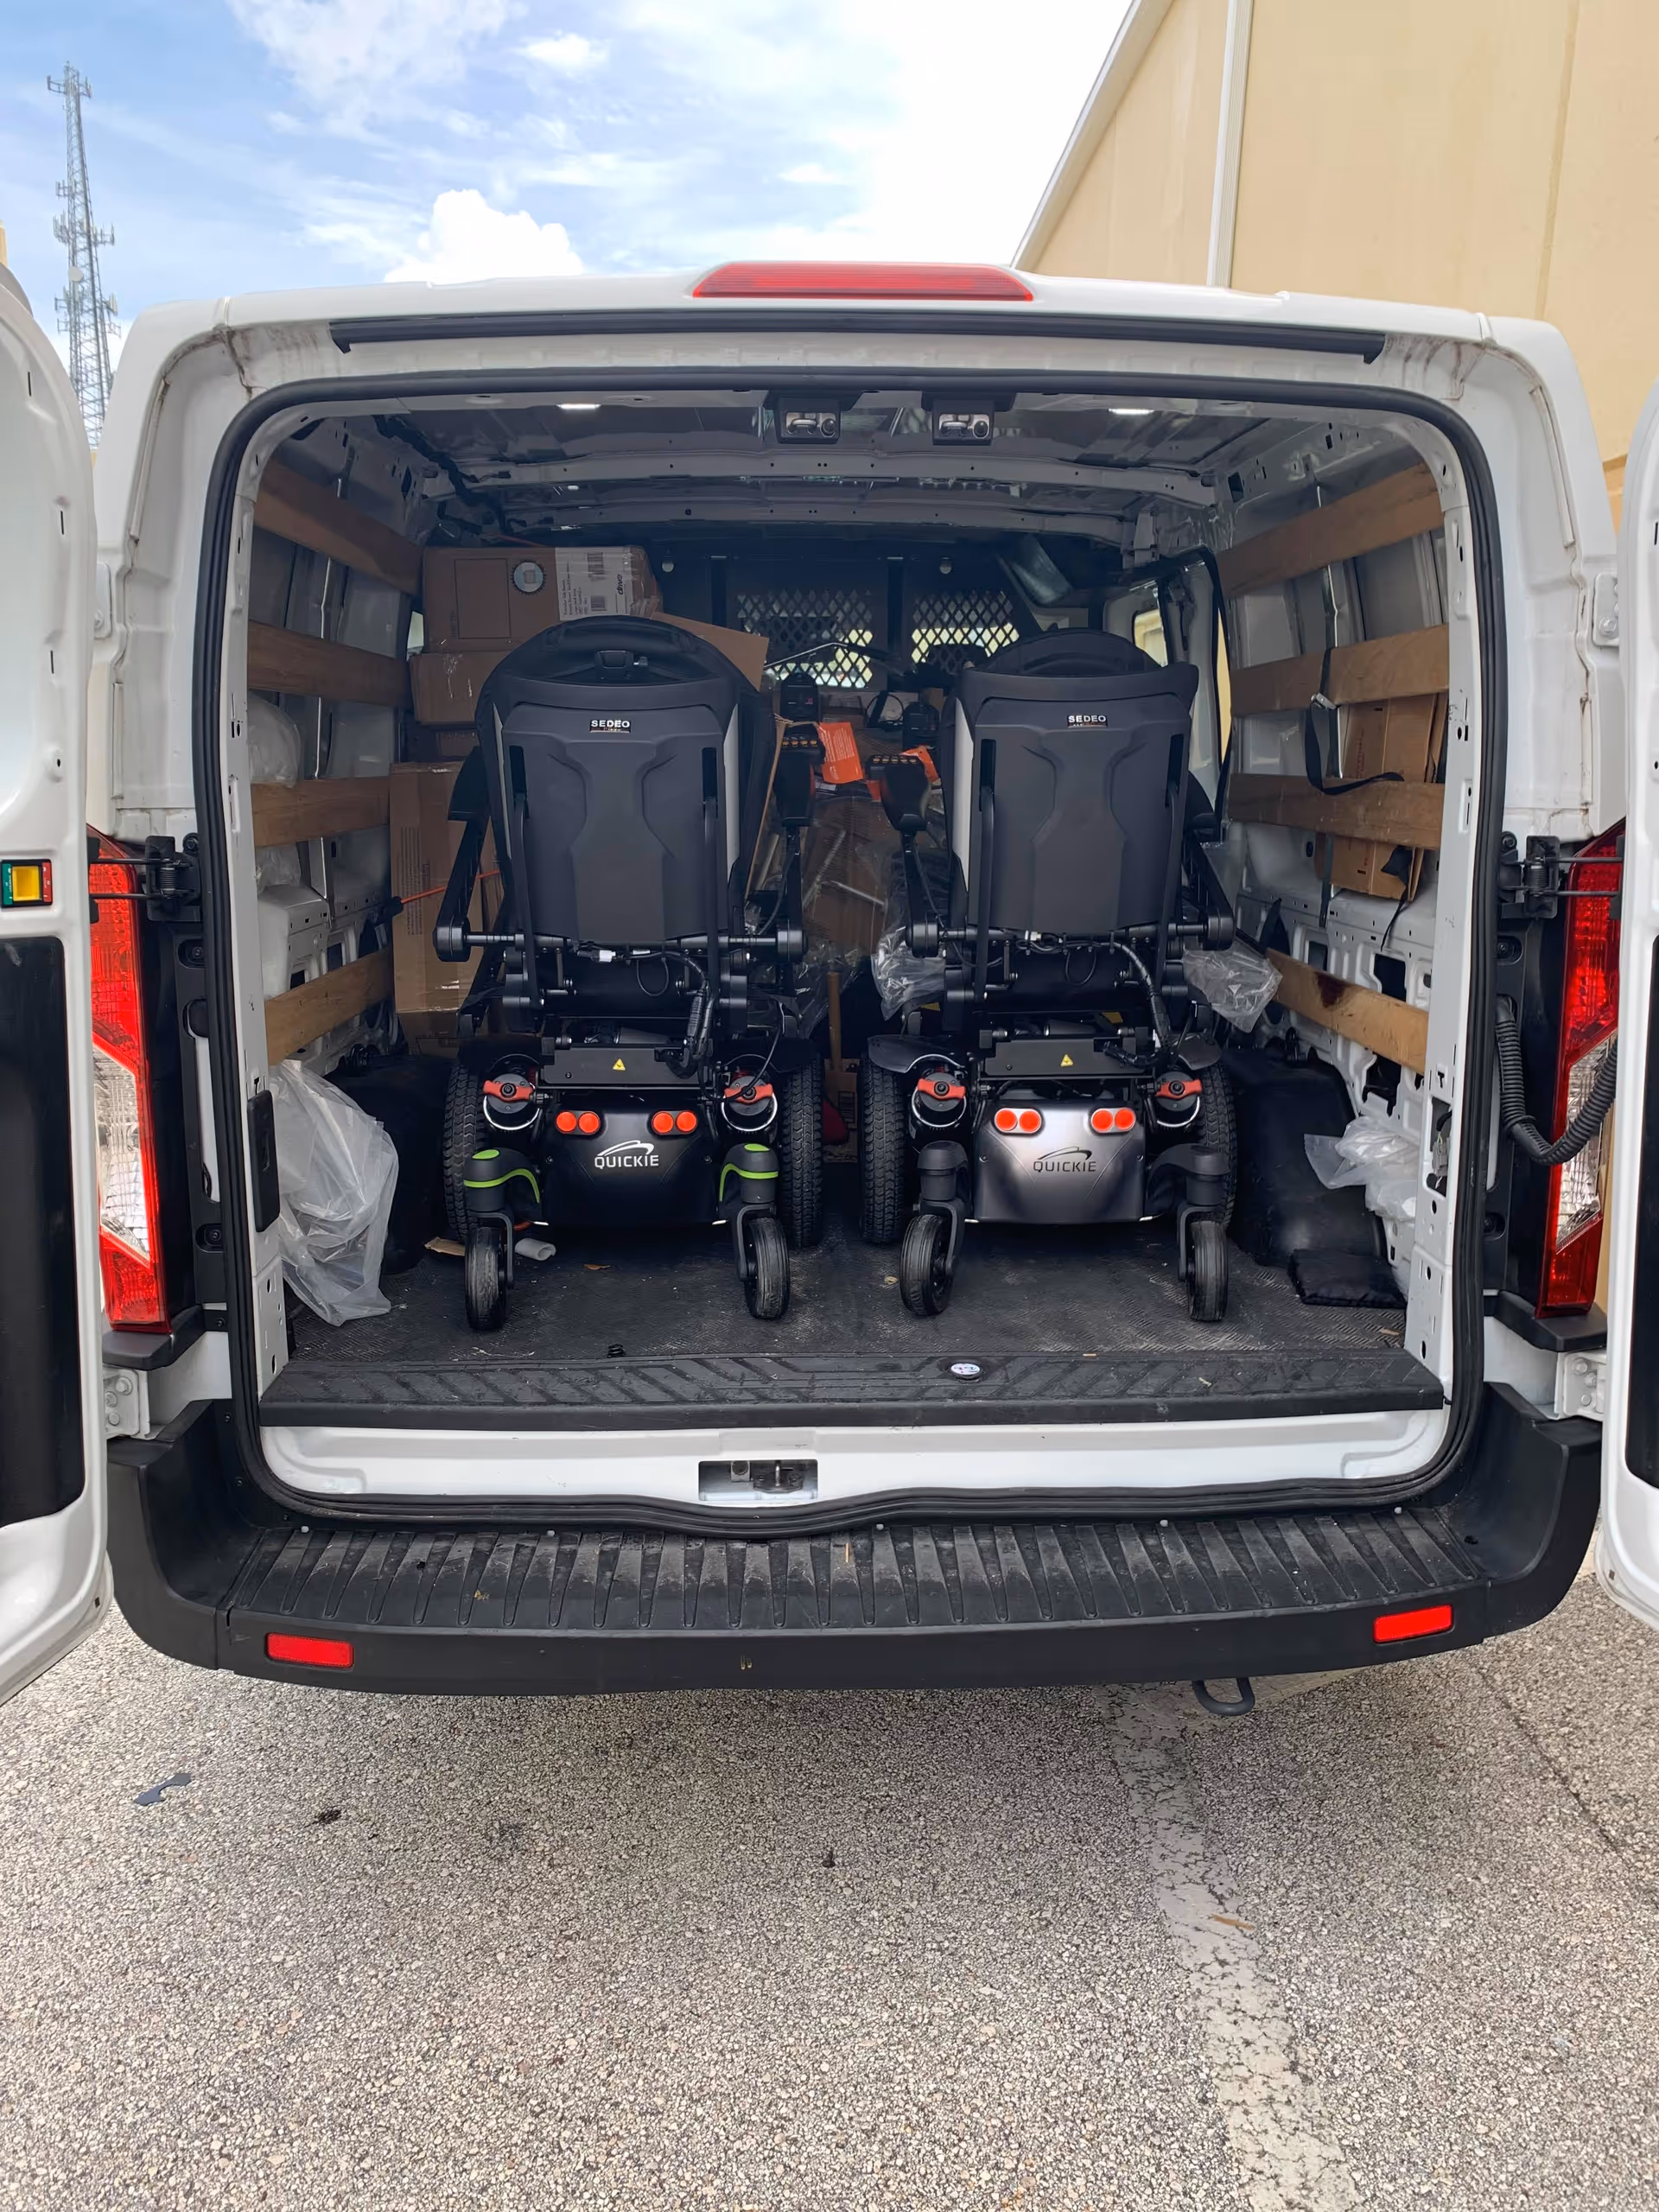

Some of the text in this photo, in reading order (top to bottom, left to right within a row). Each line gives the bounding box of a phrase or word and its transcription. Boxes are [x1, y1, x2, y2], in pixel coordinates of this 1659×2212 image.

[590, 720, 631, 728] SEDEO
[1068, 715, 1107, 723] SEDEO
[594, 1154, 659, 1170] QUICKIE
[1033, 1160, 1096, 1173] QUICKIE
